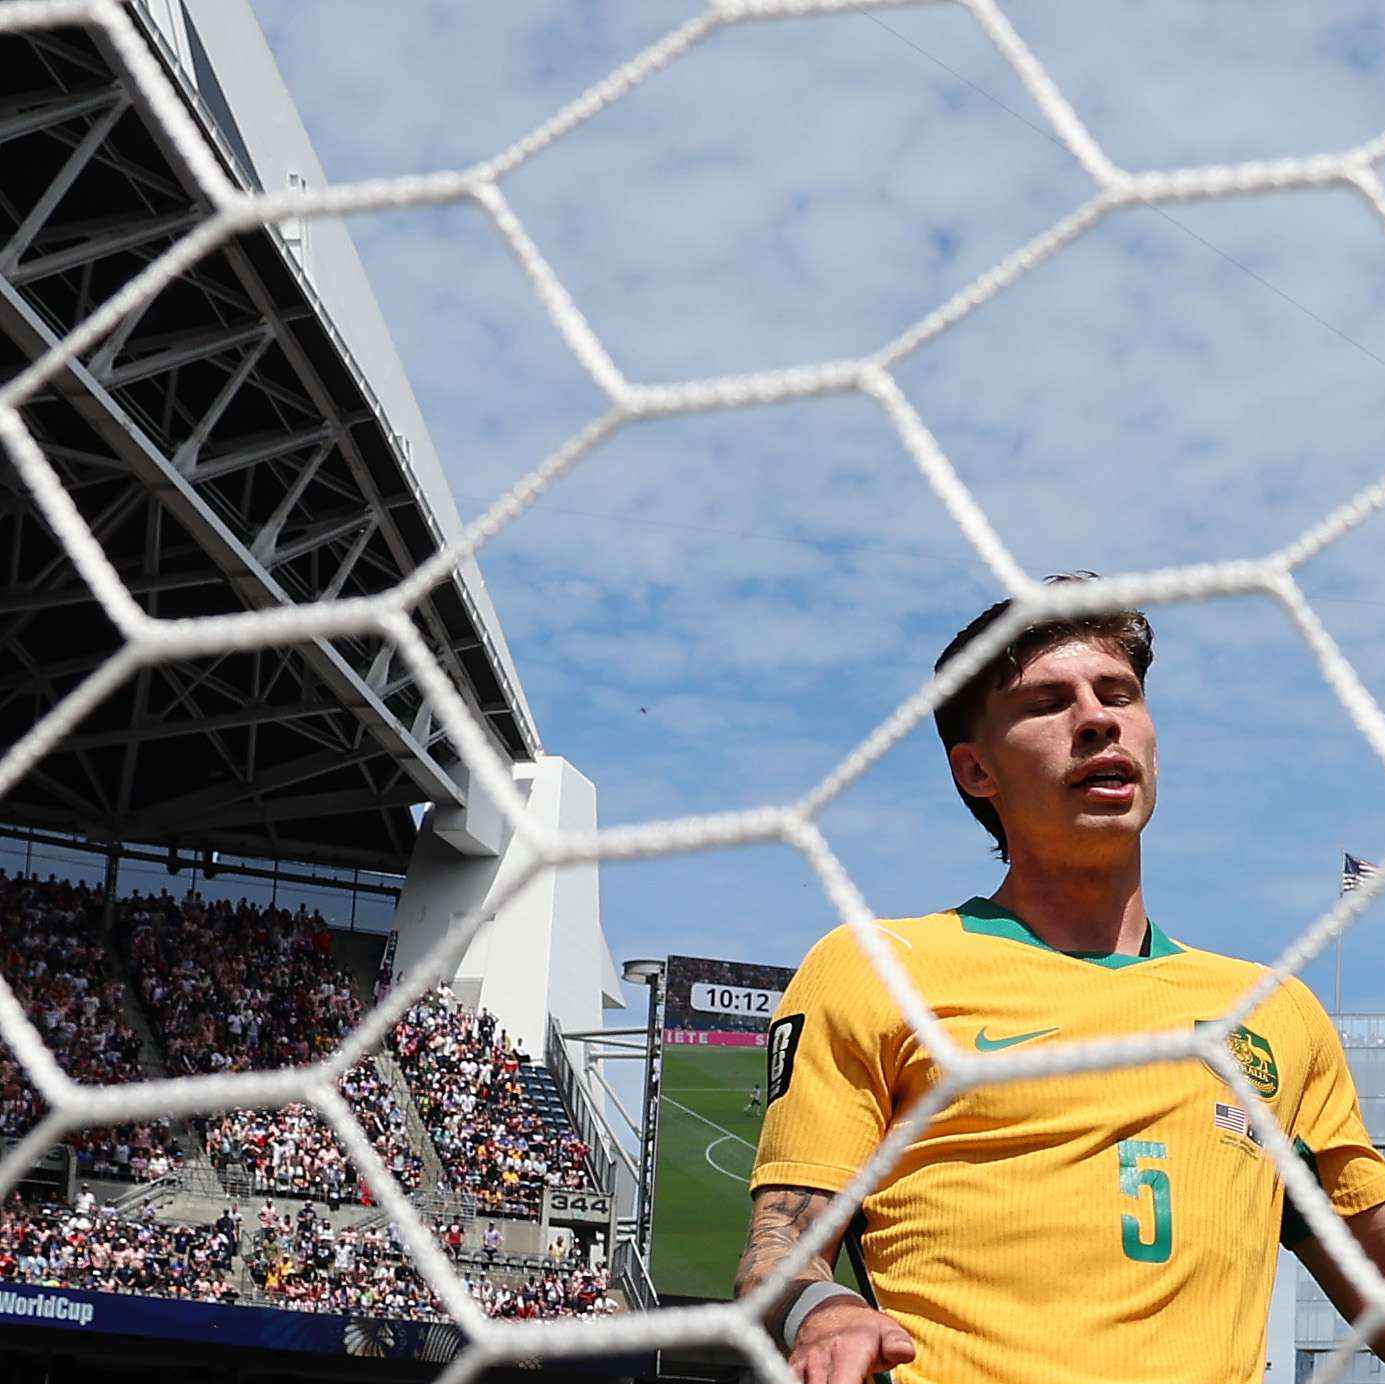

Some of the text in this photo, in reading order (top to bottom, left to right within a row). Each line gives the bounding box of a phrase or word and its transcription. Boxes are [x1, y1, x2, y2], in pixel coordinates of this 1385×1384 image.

[706, 988, 770, 1012] 10:12
[666, 1032, 709, 1044] IETE
[551, 1195, 608, 1213] 344
[1117, 1139, 1173, 1264] 5
